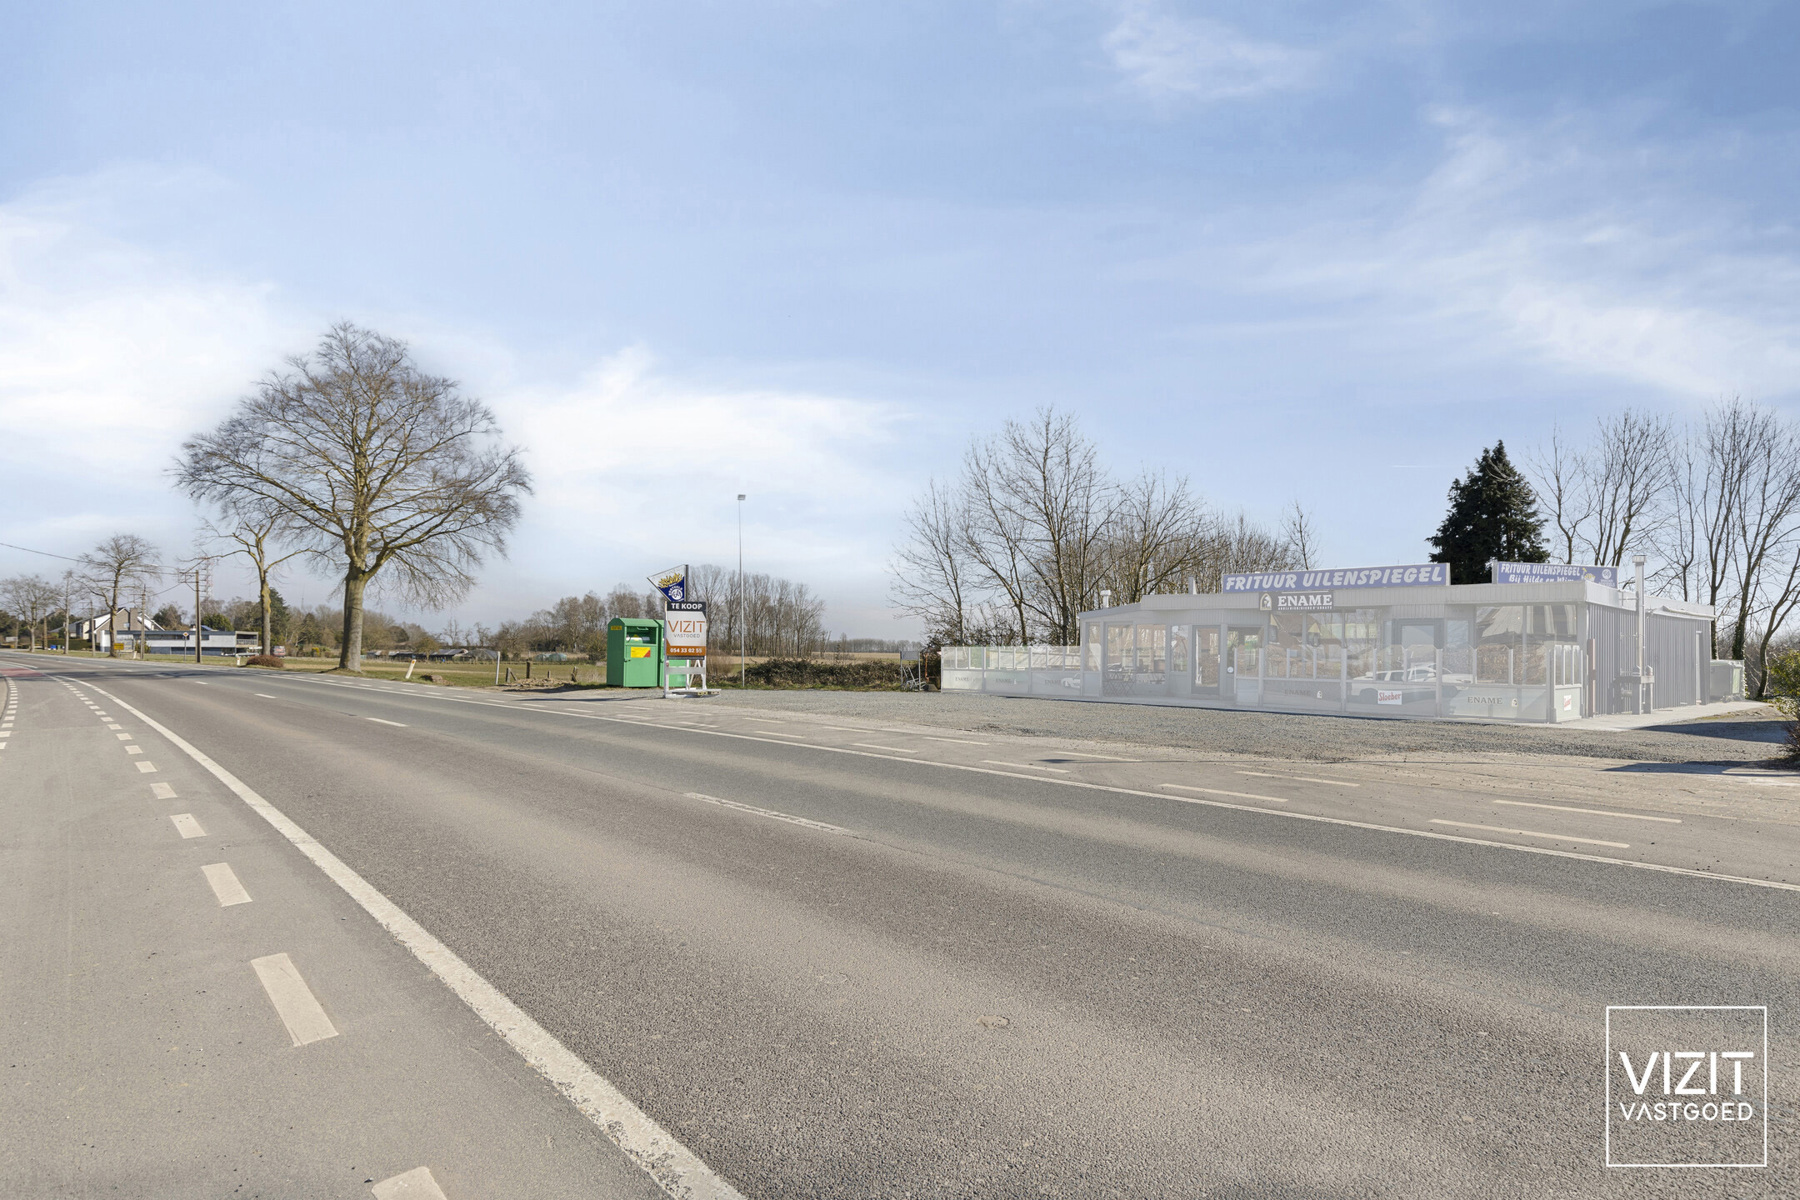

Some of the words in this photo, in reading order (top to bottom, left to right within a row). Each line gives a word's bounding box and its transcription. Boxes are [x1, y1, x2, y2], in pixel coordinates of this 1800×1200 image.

[1501, 563, 1531, 575] FRITUUR
[1532, 565, 1580, 576] UILENSPIEGEL
[1226, 574, 1296, 591] FRITUUR
[1302, 566, 1443, 587] UILENSPIEGEL
[1277, 594, 1332, 607] ENAME
[668, 620, 705, 633] VIZIT
[1467, 696, 1503, 704] ENAME
